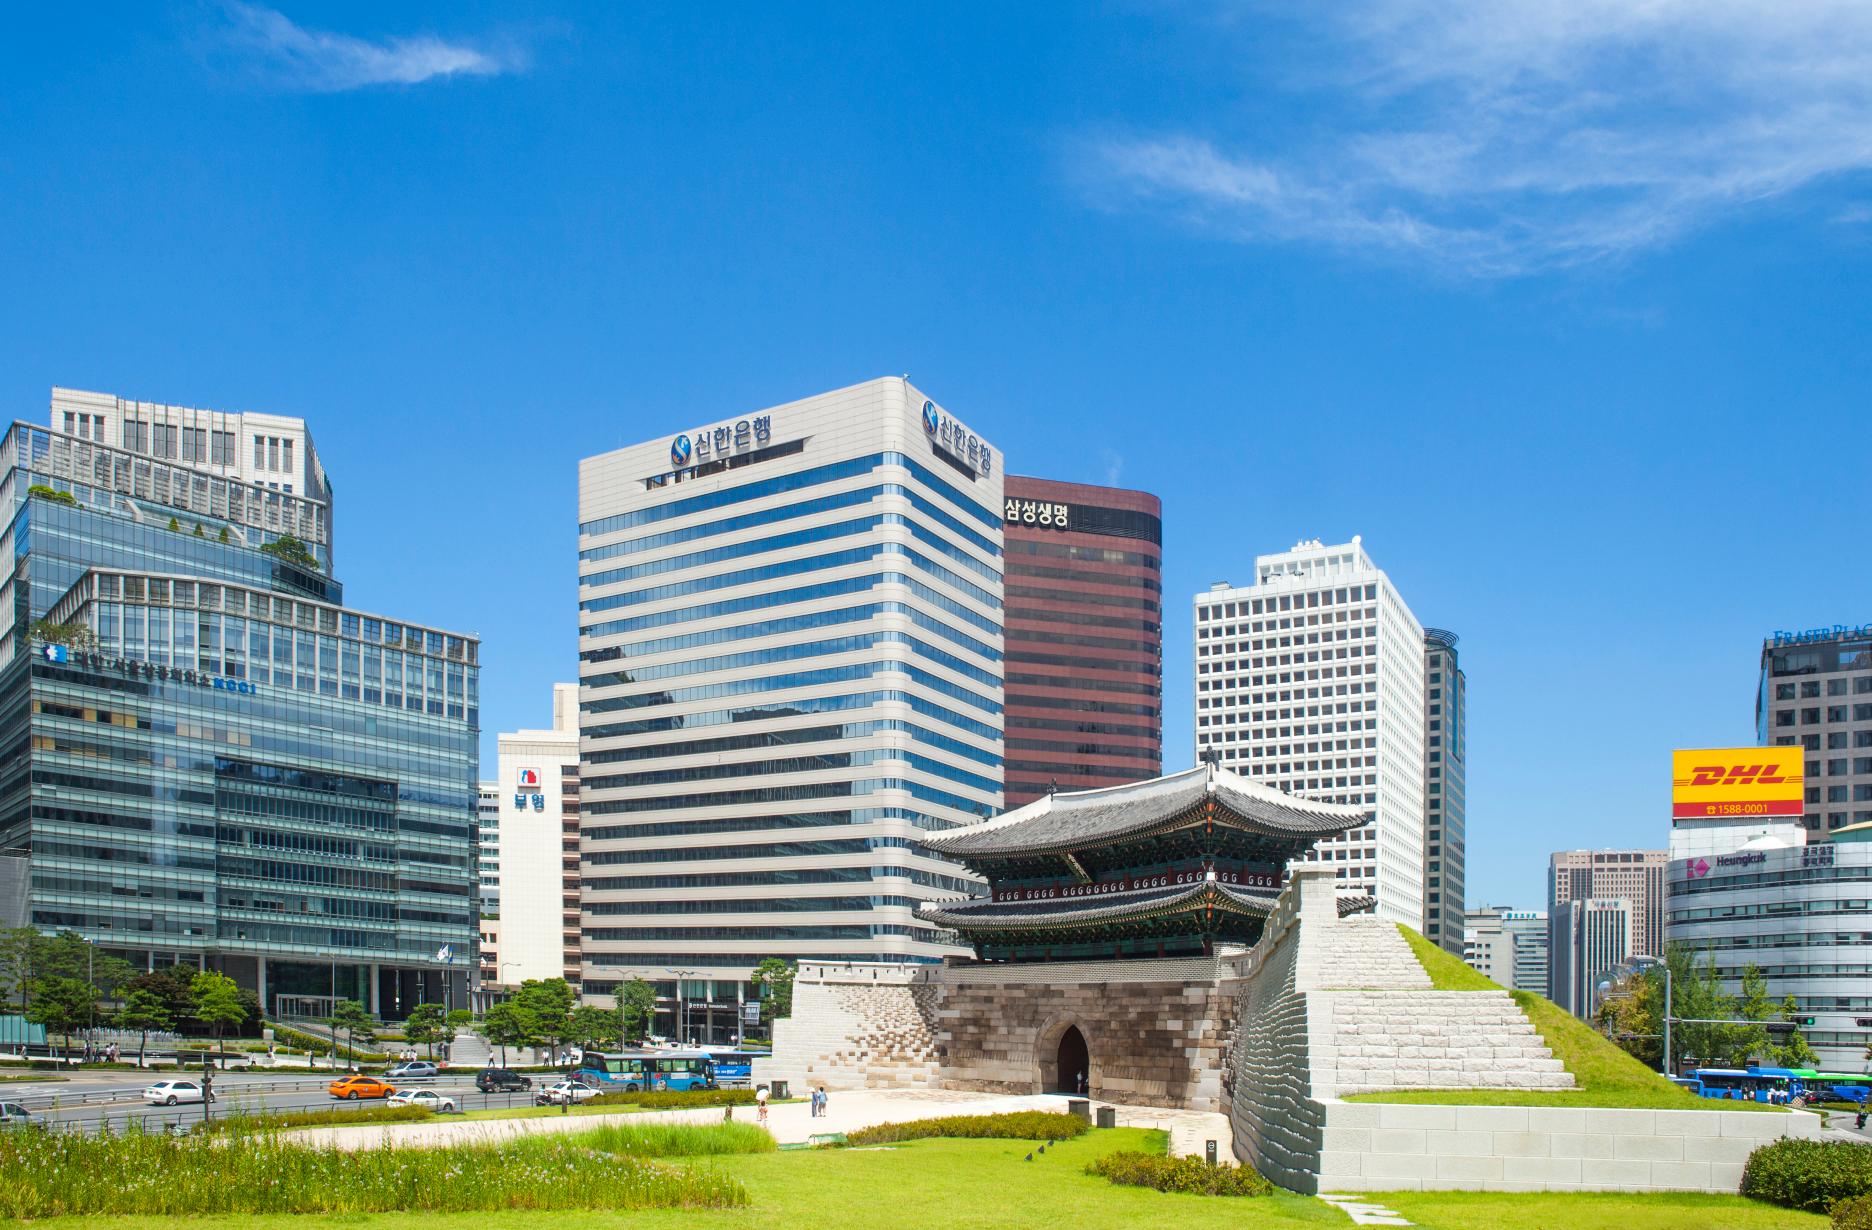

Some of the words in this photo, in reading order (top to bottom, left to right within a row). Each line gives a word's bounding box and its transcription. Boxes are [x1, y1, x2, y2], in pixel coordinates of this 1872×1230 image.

[695, 415, 771, 456] 신한은행
[940, 416, 991, 471] 신한은행
[1005, 499, 1068, 527] 삼성생명
[1773, 628, 1830, 646] FRASER
[213, 677, 257, 695] KCCI
[1690, 764, 1787, 786] DHL
[515, 793, 545, 811] 부영
[1718, 803, 1768, 814] 1588-0001
[1716, 852, 1767, 867] Heungkuk
